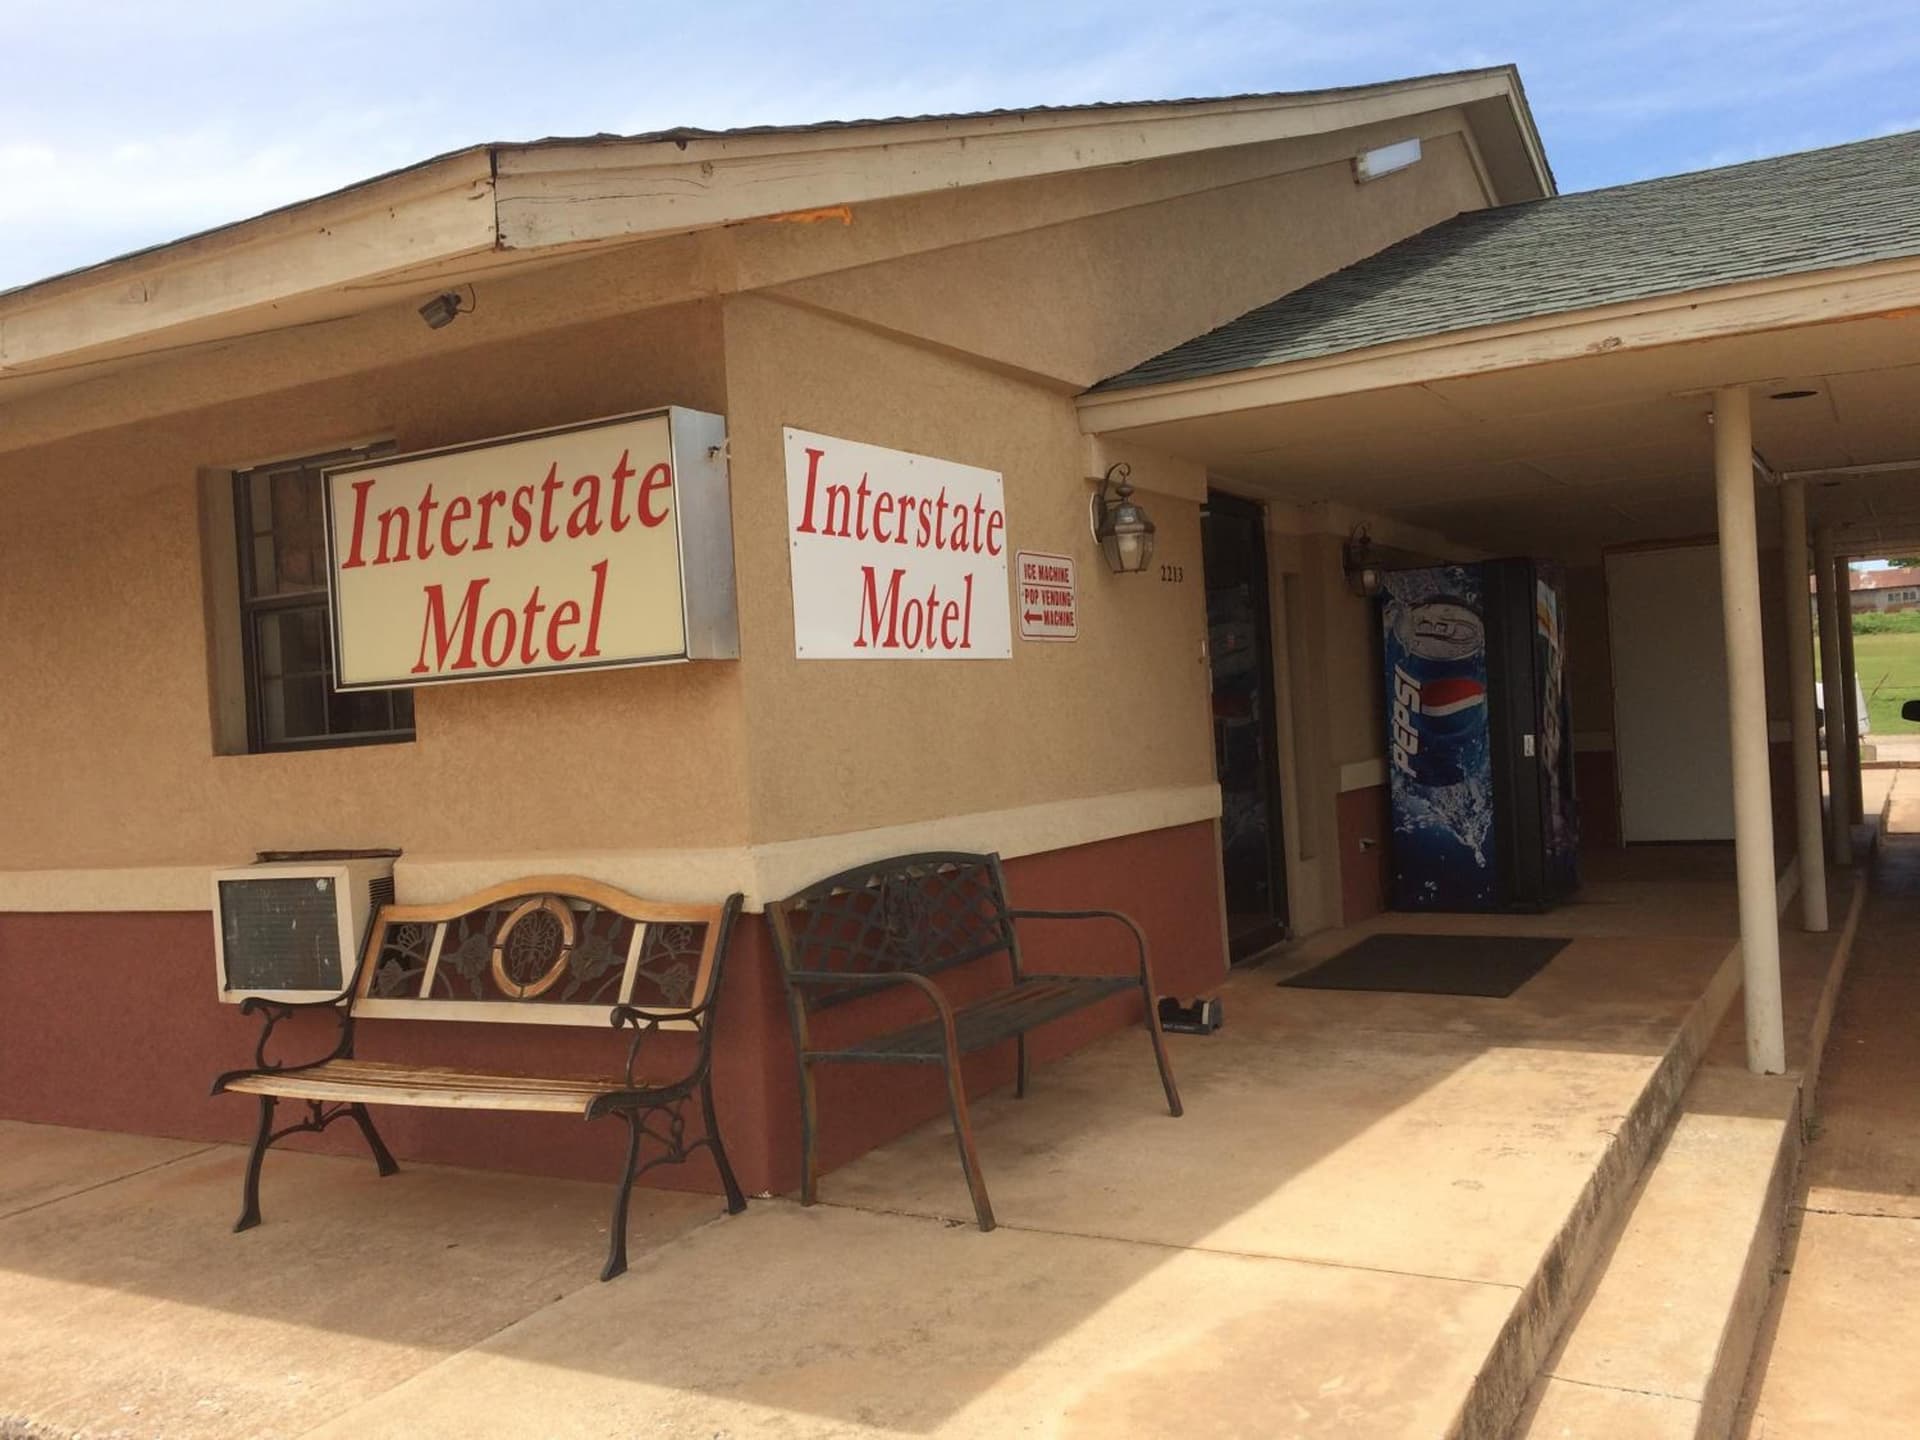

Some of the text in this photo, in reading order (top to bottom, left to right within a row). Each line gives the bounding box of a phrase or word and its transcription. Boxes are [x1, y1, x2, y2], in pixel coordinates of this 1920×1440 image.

[342, 449, 671, 569] Interstate
[797, 448, 1004, 556] Interstate
[411, 559, 608, 673] Motel
[853, 566, 974, 649] Motel
[1024, 563, 1069, 583] ICE MACHINE
[1025, 588, 1071, 607] POP VENDING
[1043, 610, 1074, 627] MACHINE
[1392, 663, 1421, 778] PEPSI
